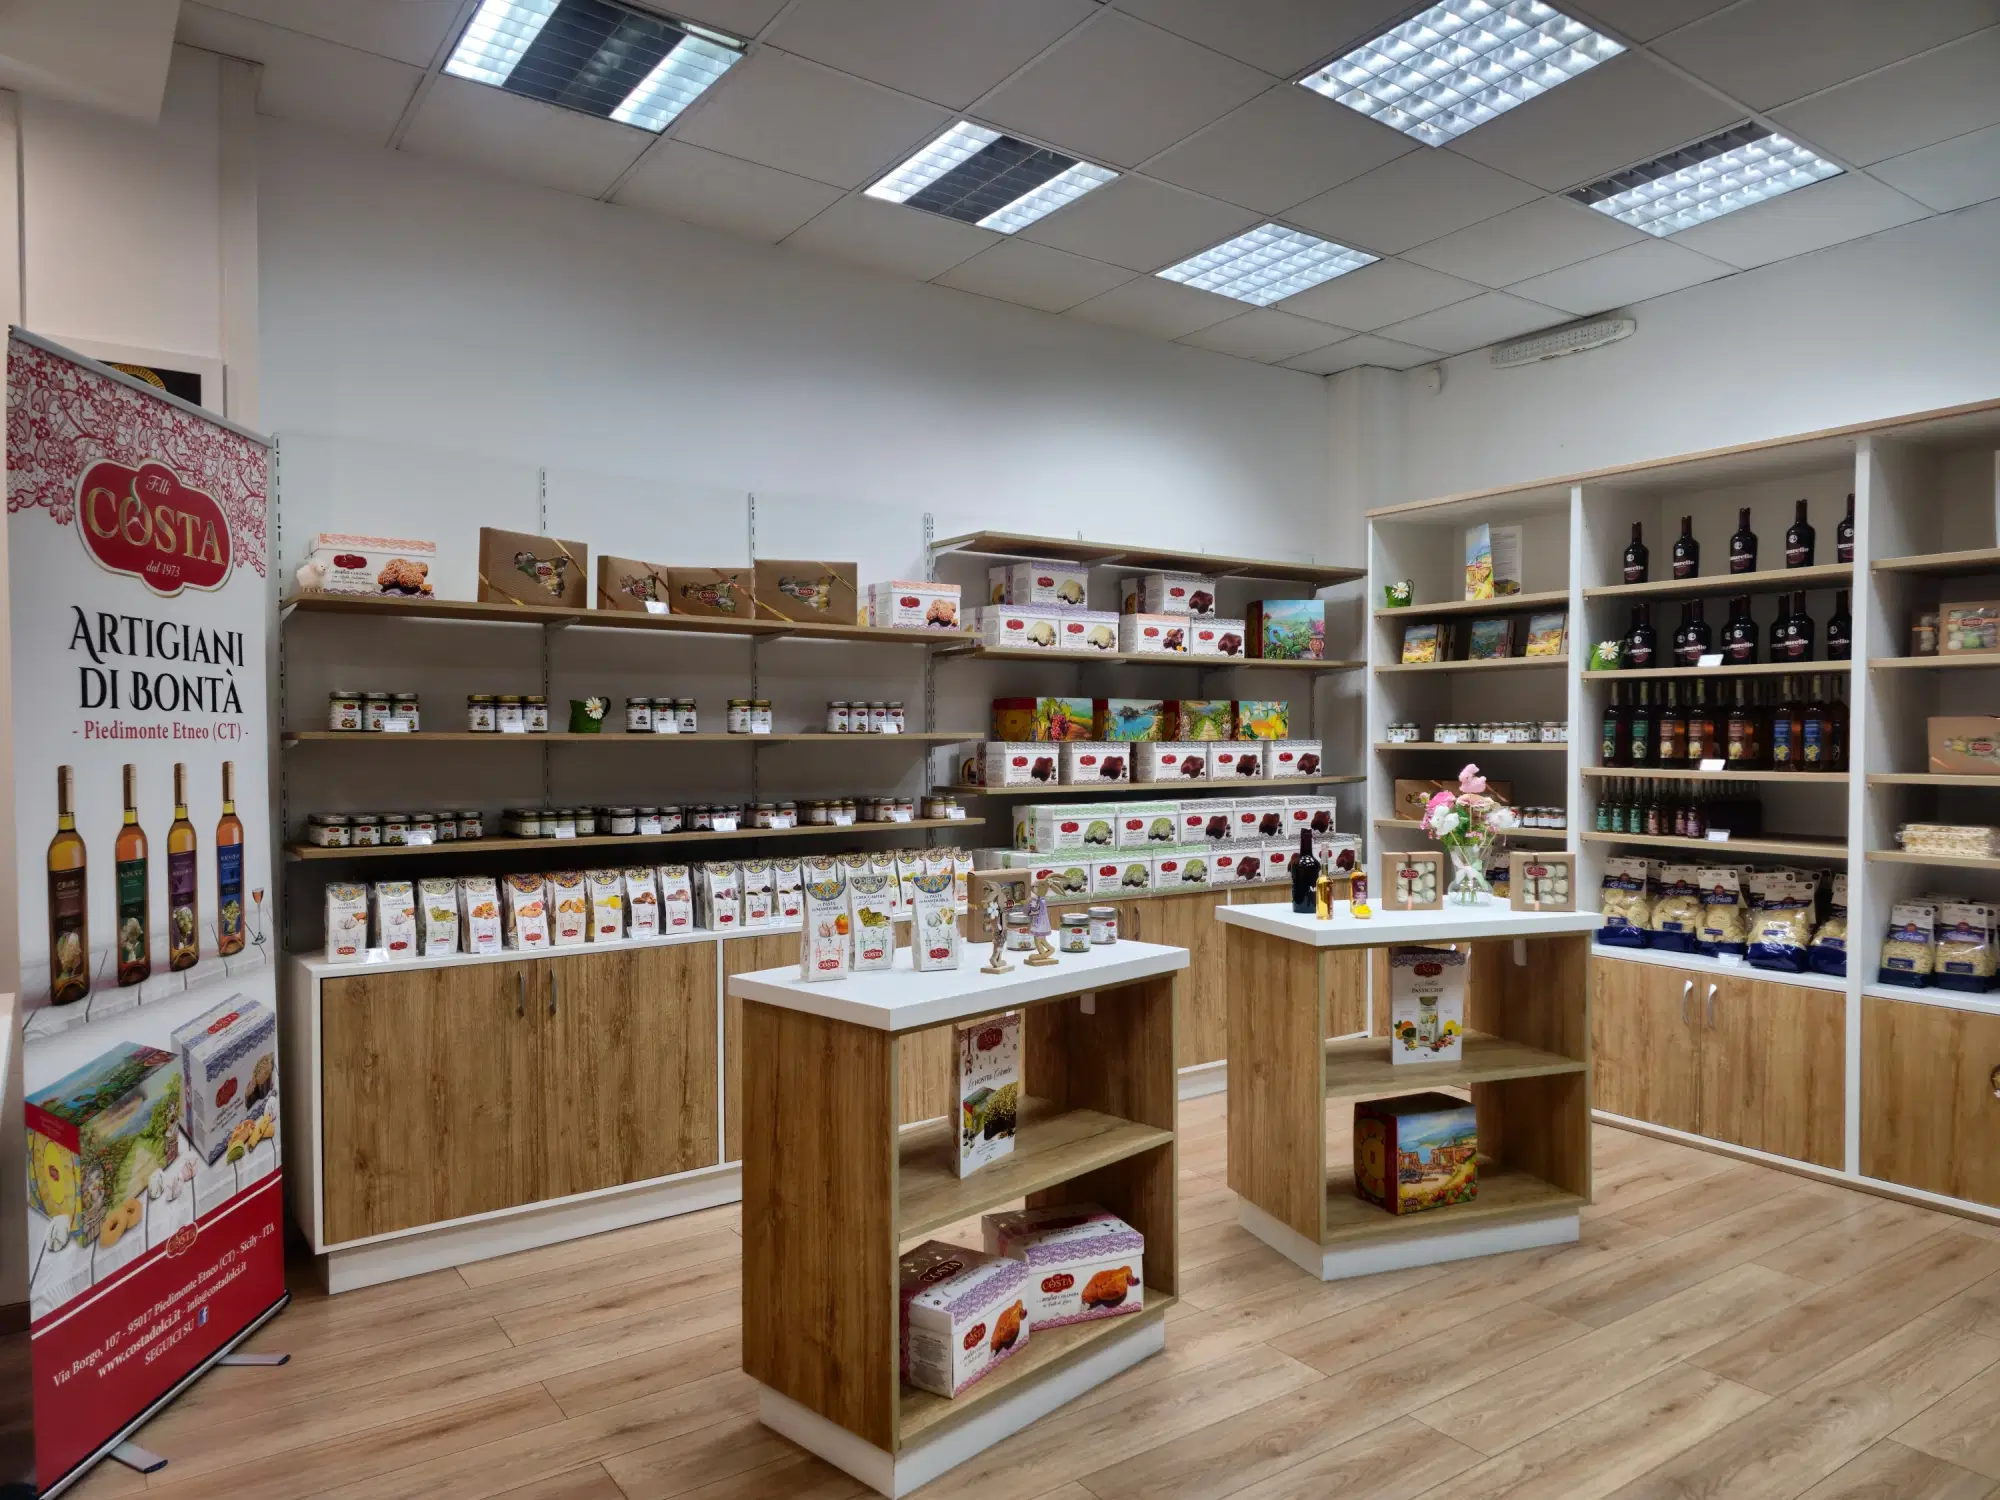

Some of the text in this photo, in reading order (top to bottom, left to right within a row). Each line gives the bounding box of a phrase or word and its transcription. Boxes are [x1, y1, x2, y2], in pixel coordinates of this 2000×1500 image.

[86, 486, 225, 566] COSTA
[146, 562, 180, 578] dal 1973
[68, 605, 244, 667] ARTIGIANI
[79, 666, 243, 714] DI BONTÀ
[84, 720, 242, 742] Piedimonte Etneo (CT)
[52, 1224, 275, 1387] Via Borgo, 107 95017 Piedimonte Etneo (CT) Sicily ITA
[1042, 1277, 1073, 1290] COSTA
[97, 1262, 248, 1378] www.costadolci.it info@costadolci.it
[144, 1318, 195, 1365] SEGUICI SU
[964, 1326, 986, 1348] COSTA
